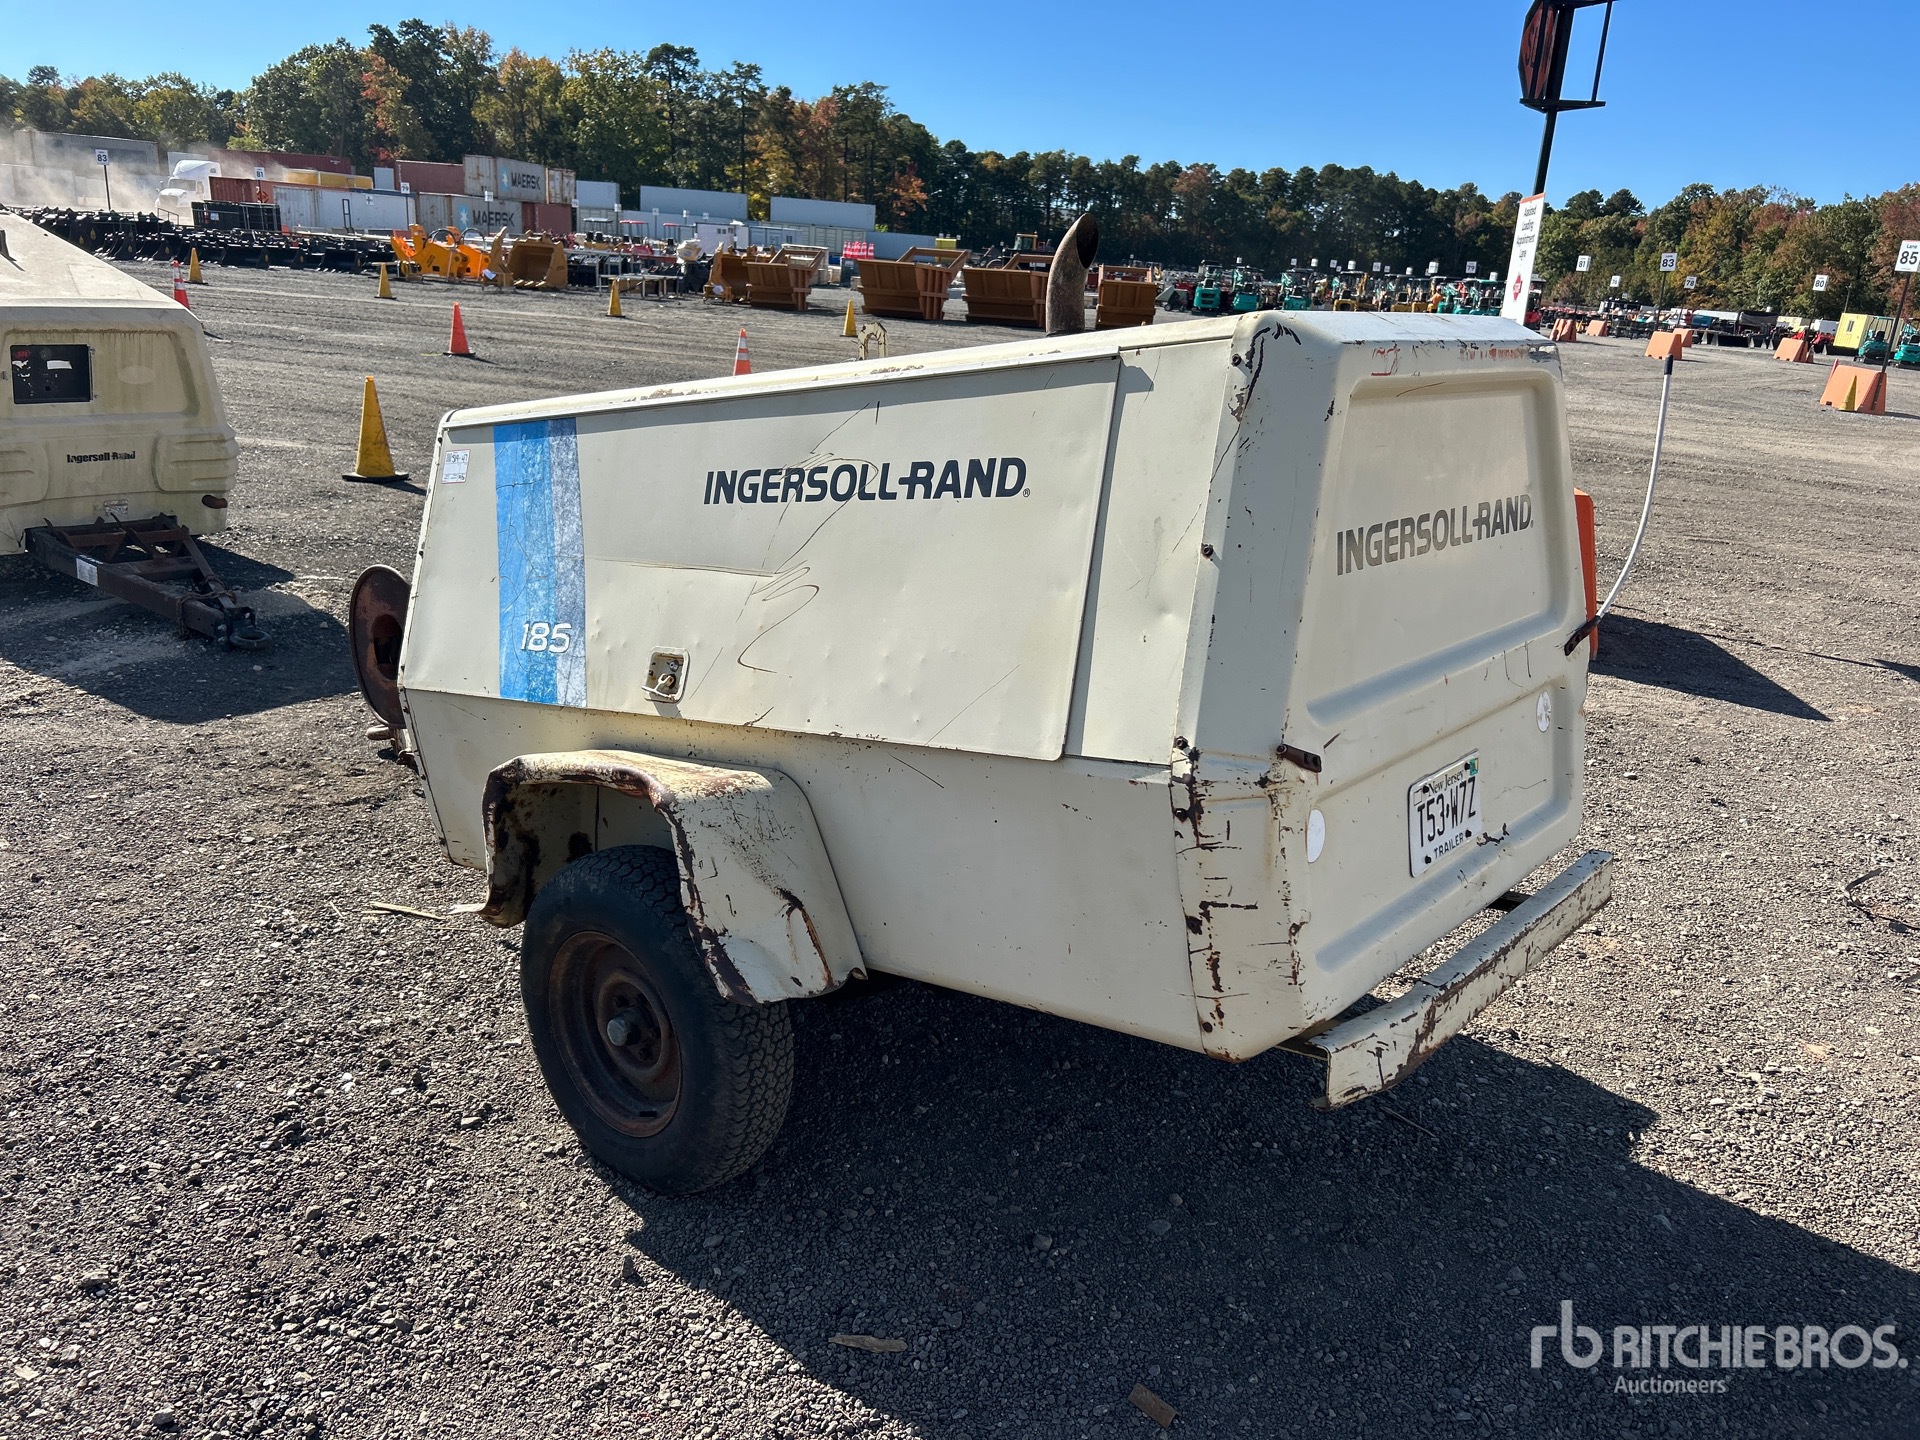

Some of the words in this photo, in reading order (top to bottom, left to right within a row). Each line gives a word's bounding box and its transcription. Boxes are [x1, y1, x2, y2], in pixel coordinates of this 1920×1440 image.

[96, 154, 108, 162] 83
[256, 170, 264, 178] 81
[511, 172, 541, 190] MAERSK
[473, 210, 516, 227] MAERSK
[1661, 258, 1675, 268] 83
[1899, 250, 1919, 265] 85
[1814, 279, 1825, 288] 80
[520, 621, 573, 653] 185
[1427, 780, 1444, 797] New
[1444, 769, 1465, 792] Jersey
[1433, 832, 1465, 859] TRAILER
